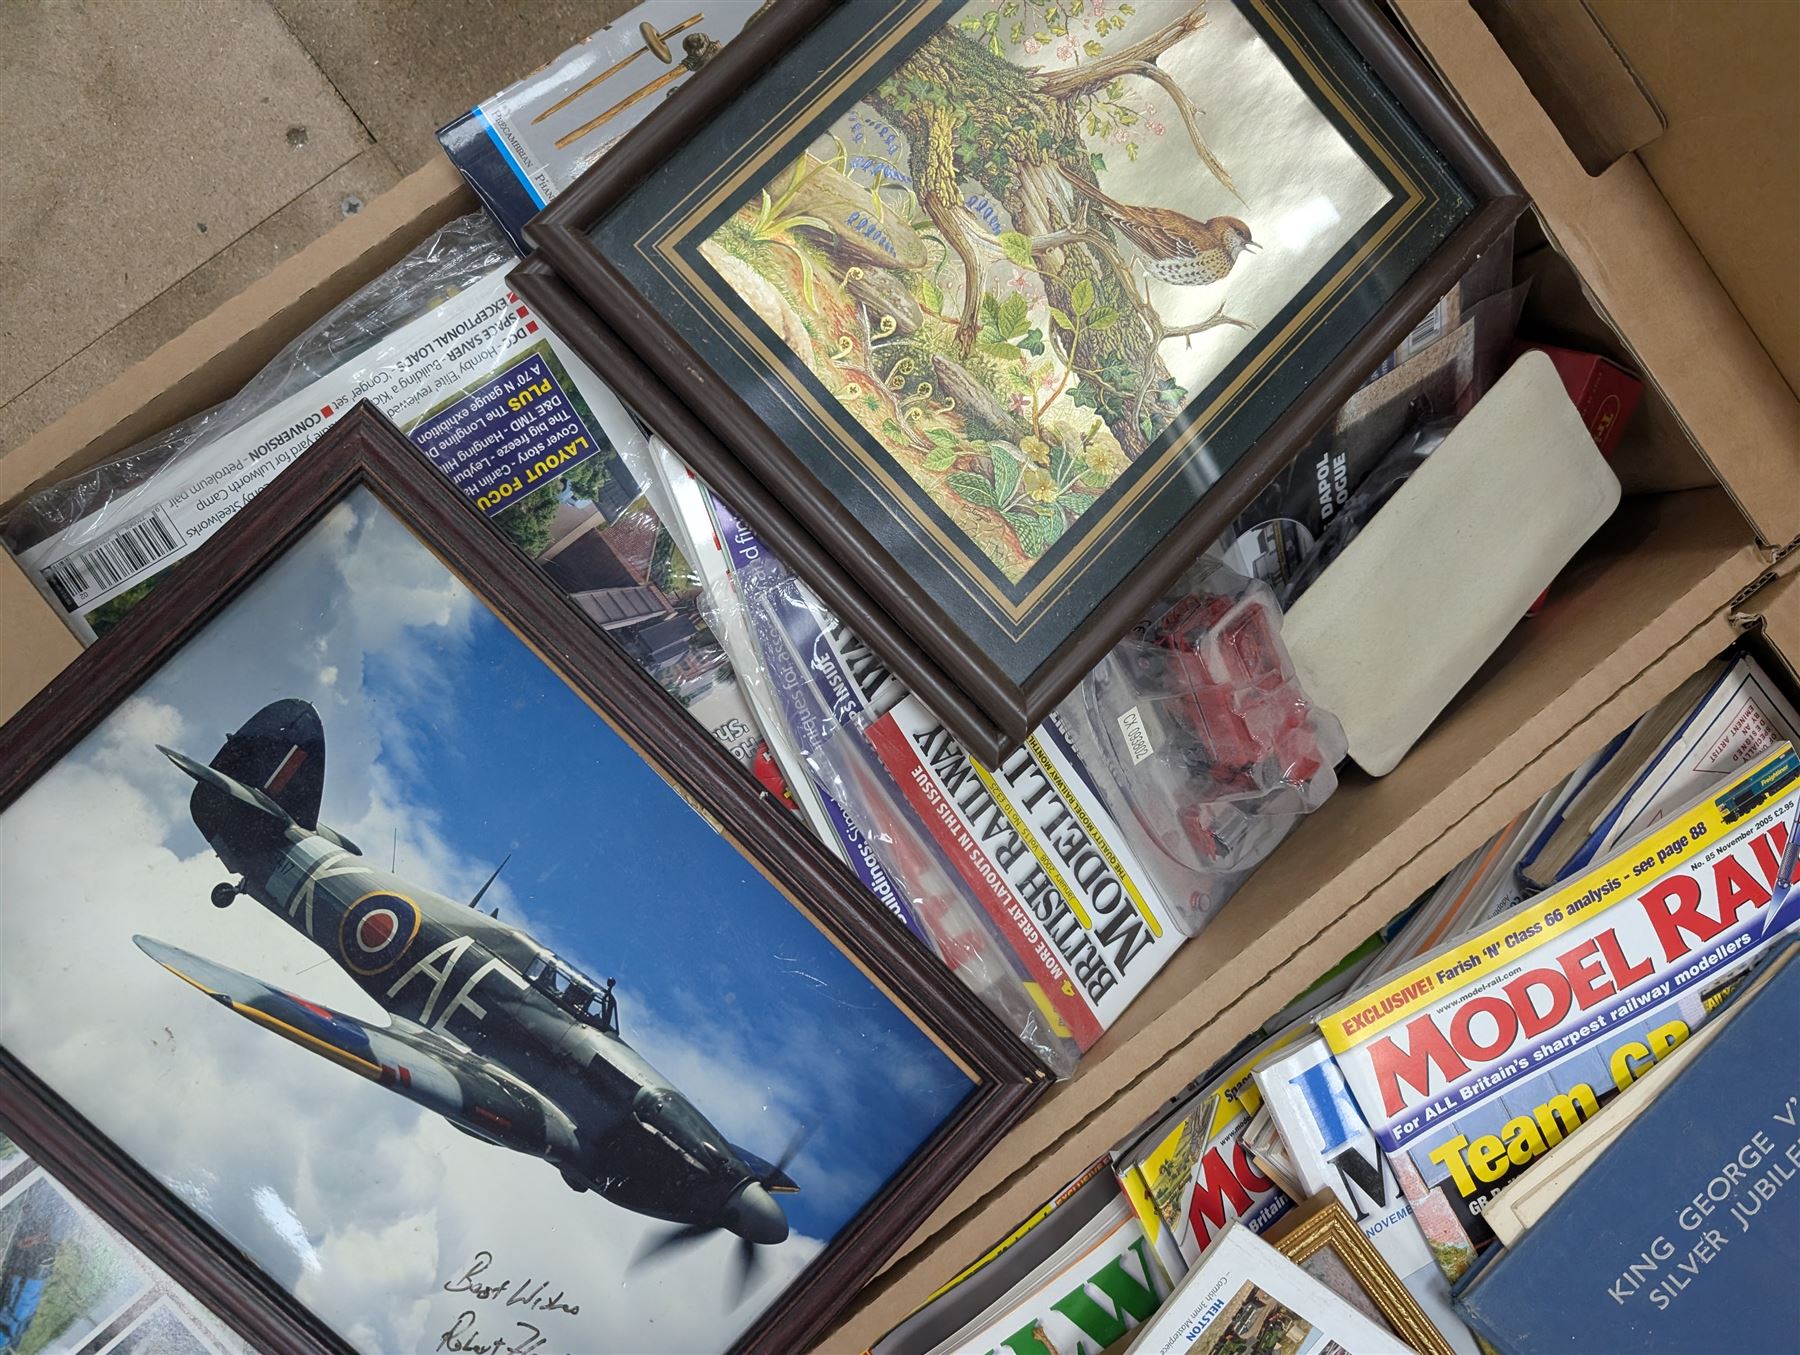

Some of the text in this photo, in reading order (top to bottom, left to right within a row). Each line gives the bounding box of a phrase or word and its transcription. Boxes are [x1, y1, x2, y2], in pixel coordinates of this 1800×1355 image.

[434, 296, 509, 348] EXCEPTIONAL
[480, 311, 518, 340] SPACE
[394, 340, 438, 373] LOADS
[445, 332, 483, 362] SAVER
[455, 342, 498, 376] Hornby
[396, 356, 443, 391] Building
[502, 379, 515, 393] N
[529, 362, 542, 376] A
[330, 393, 350, 411] set
[385, 384, 434, 420] reviewed
[466, 383, 503, 412] gauge
[506, 377, 552, 412] PLUS
[534, 394, 562, 416] D&E
[415, 406, 471, 446] exhibition
[484, 403, 508, 424] The
[508, 409, 537, 432] TMD
[526, 418, 549, 439] big
[546, 407, 570, 428] The
[247, 411, 322, 462] CONVERSION
[287, 434, 315, 458] yard
[435, 414, 487, 453] Longline
[454, 426, 505, 464] Hanging
[494, 431, 531, 460] freeze
[544, 422, 579, 449] Cover
[272, 450, 291, 467] for
[514, 439, 547, 465] story
[521, 434, 589, 483] LAYOUT
[188, 458, 244, 497] Petroleum
[226, 459, 275, 495] Lulworth
[477, 462, 512, 489] Carlin
[1316, 451, 1333, 519] DAPOL
[193, 484, 229, 514] Camp
[184, 499, 243, 541] Steelworks
[815, 651, 850, 701] INSIDE
[1122, 712, 1148, 759] CX 093802
[1708, 704, 1755, 763] EMINENT ARTIST
[1731, 718, 1766, 762] DESIGNED
[1741, 711, 1760, 735] BY AN
[1024, 732, 1053, 771] MONTHL
[1741, 725, 1771, 763] SPECIALLY
[1048, 768, 1075, 804] RAILWAY
[1009, 812, 1022, 826] No
[1070, 800, 1096, 833] MODEL
[1026, 837, 1040, 851] Vol
[1090, 830, 1117, 864] QUALITY
[1689, 799, 1796, 872] No. 85 November 2005 £2.95
[762, 722, 1119, 1006] BRITISH RAILWAY
[909, 764, 1077, 999] 4 MORE GREAT LAYOUTS IN THIS ISSUE
[1112, 862, 1127, 880] THE
[1050, 871, 1076, 902] January
[1341, 975, 1434, 1037] EXCLUSIVE!
[1435, 952, 1482, 985] Farish
[1502, 918, 1543, 949] Class
[1542, 907, 1565, 927] 66
[1563, 875, 1624, 917] analysis
[1630, 855, 1657, 877] see
[1653, 833, 1692, 864] page
[1686, 820, 1709, 841] 88
[1367, 928, 1655, 1117] MODEL
[1390, 1114, 1423, 1141] For
[1421, 1093, 1459, 1123] ALL
[1529, 1012, 1610, 1064] sharpest
[1607, 977, 1673, 1024] railway
[1672, 930, 1752, 986] modellers
[1429, 1082, 1599, 1197] Team
[1608, 1236, 1675, 1304] KING
[1679, 1131, 1774, 1230] GEORGE
[1649, 1137, 1800, 1310] SILVER JUBILE
[446, 1252, 509, 1298] Best
[1204, 1276, 1228, 1301] Cornish
[1185, 1298, 1225, 1342] HELSTON
[1189, 1300, 1208, 1319] 3mm
